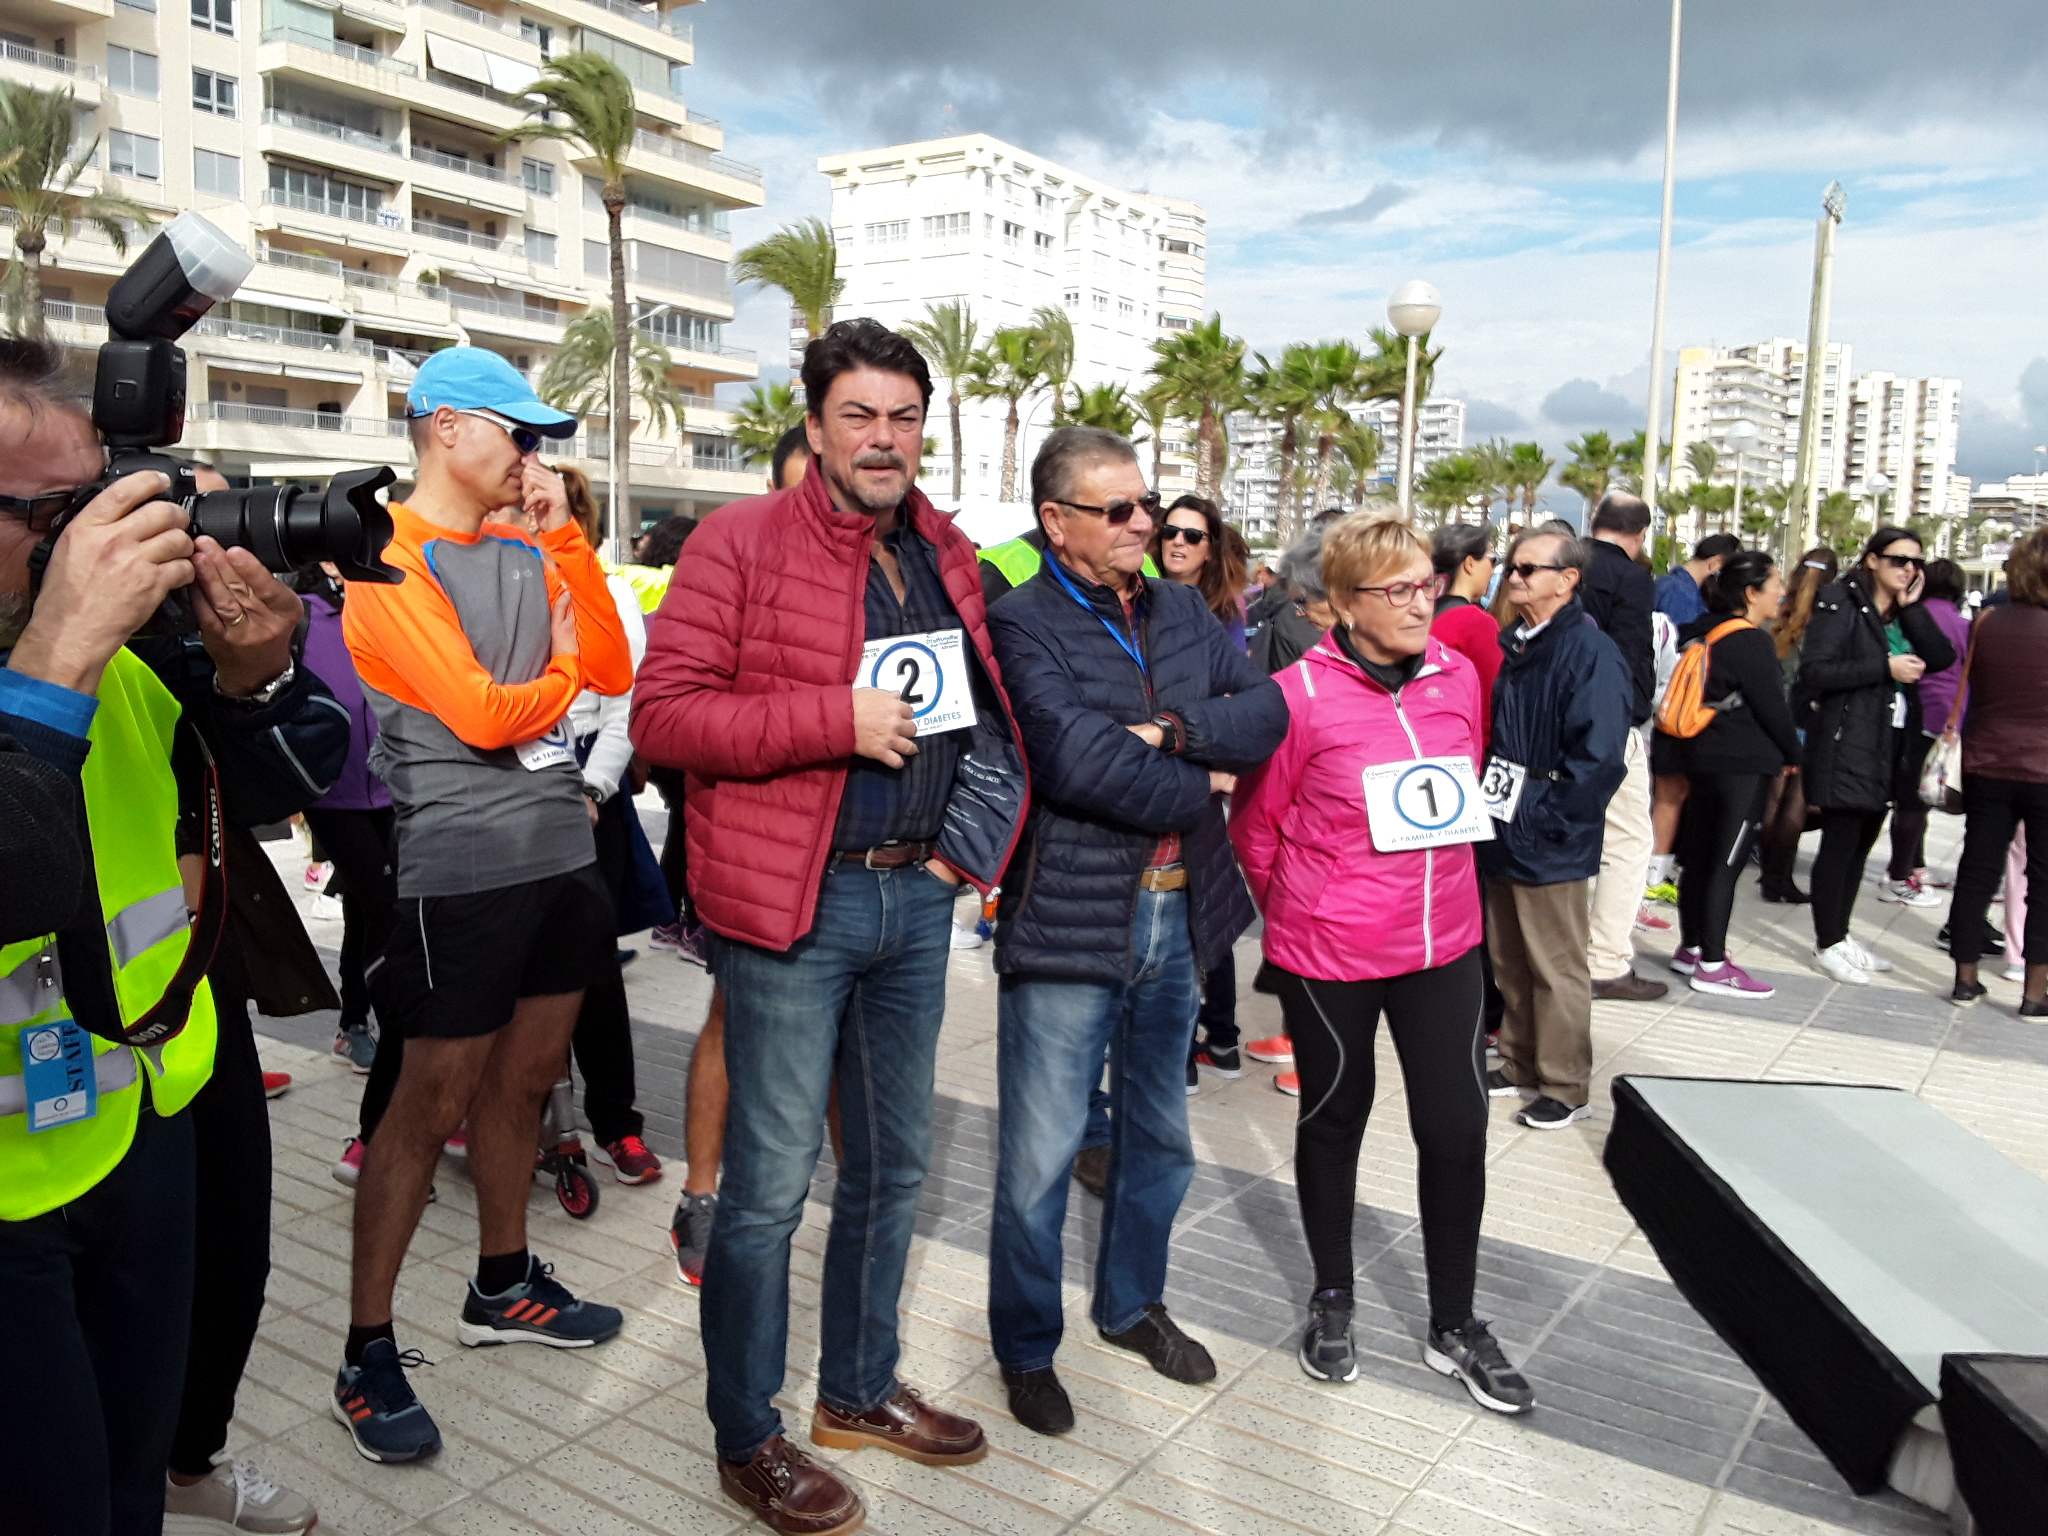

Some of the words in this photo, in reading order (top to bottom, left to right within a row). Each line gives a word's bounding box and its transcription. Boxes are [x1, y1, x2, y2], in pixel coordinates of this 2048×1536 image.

[896, 657, 924, 704] 2
[924, 711, 962, 726] DIABETES
[1416, 777, 1439, 818] 1
[1484, 772, 1515, 801] 34
[209, 787, 221, 868] Canon
[1400, 831, 1435, 842] FAMILIA
[1444, 825, 1481, 836] DIABETES
[62, 1024, 85, 1092] STAFF
